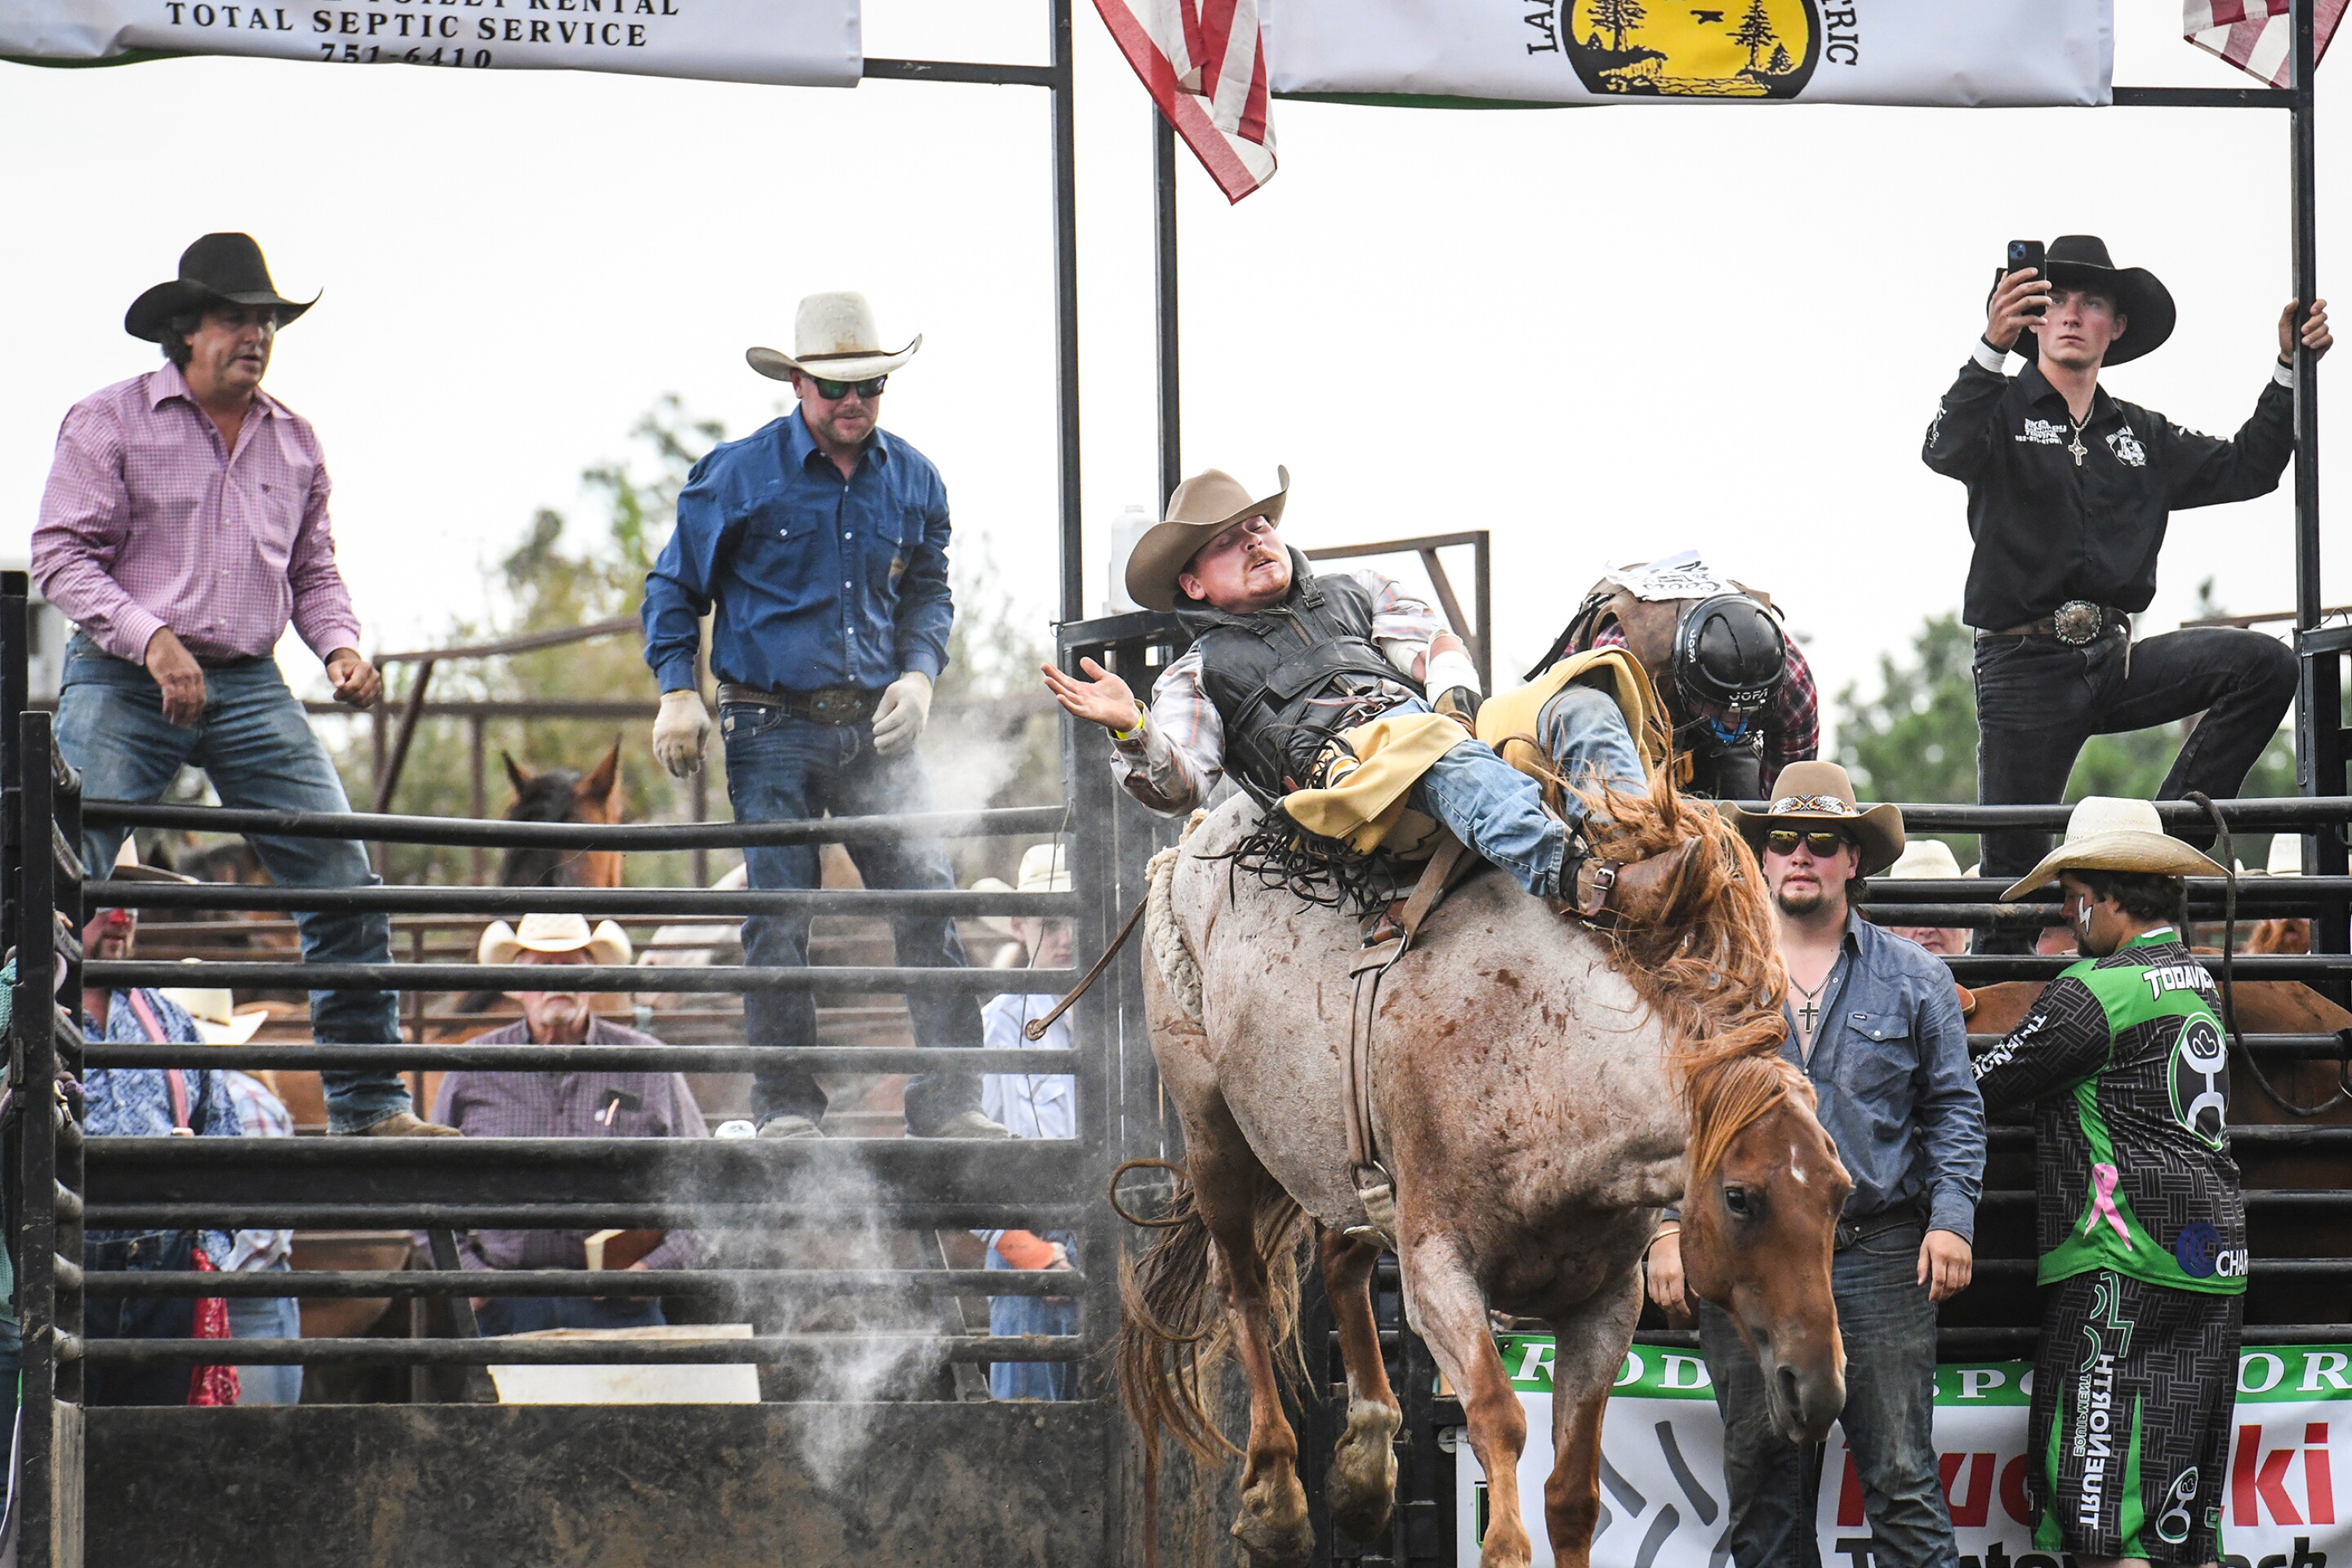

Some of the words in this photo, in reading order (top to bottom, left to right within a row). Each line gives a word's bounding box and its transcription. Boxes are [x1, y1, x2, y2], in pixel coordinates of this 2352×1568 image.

[166, 2, 294, 31] TOTAL
[313, 9, 459, 38] SEPTIC
[477, 16, 648, 47] SERVICE
[320, 42, 492, 69] 751-6410
[1729, 688, 1769, 701] JOFA
